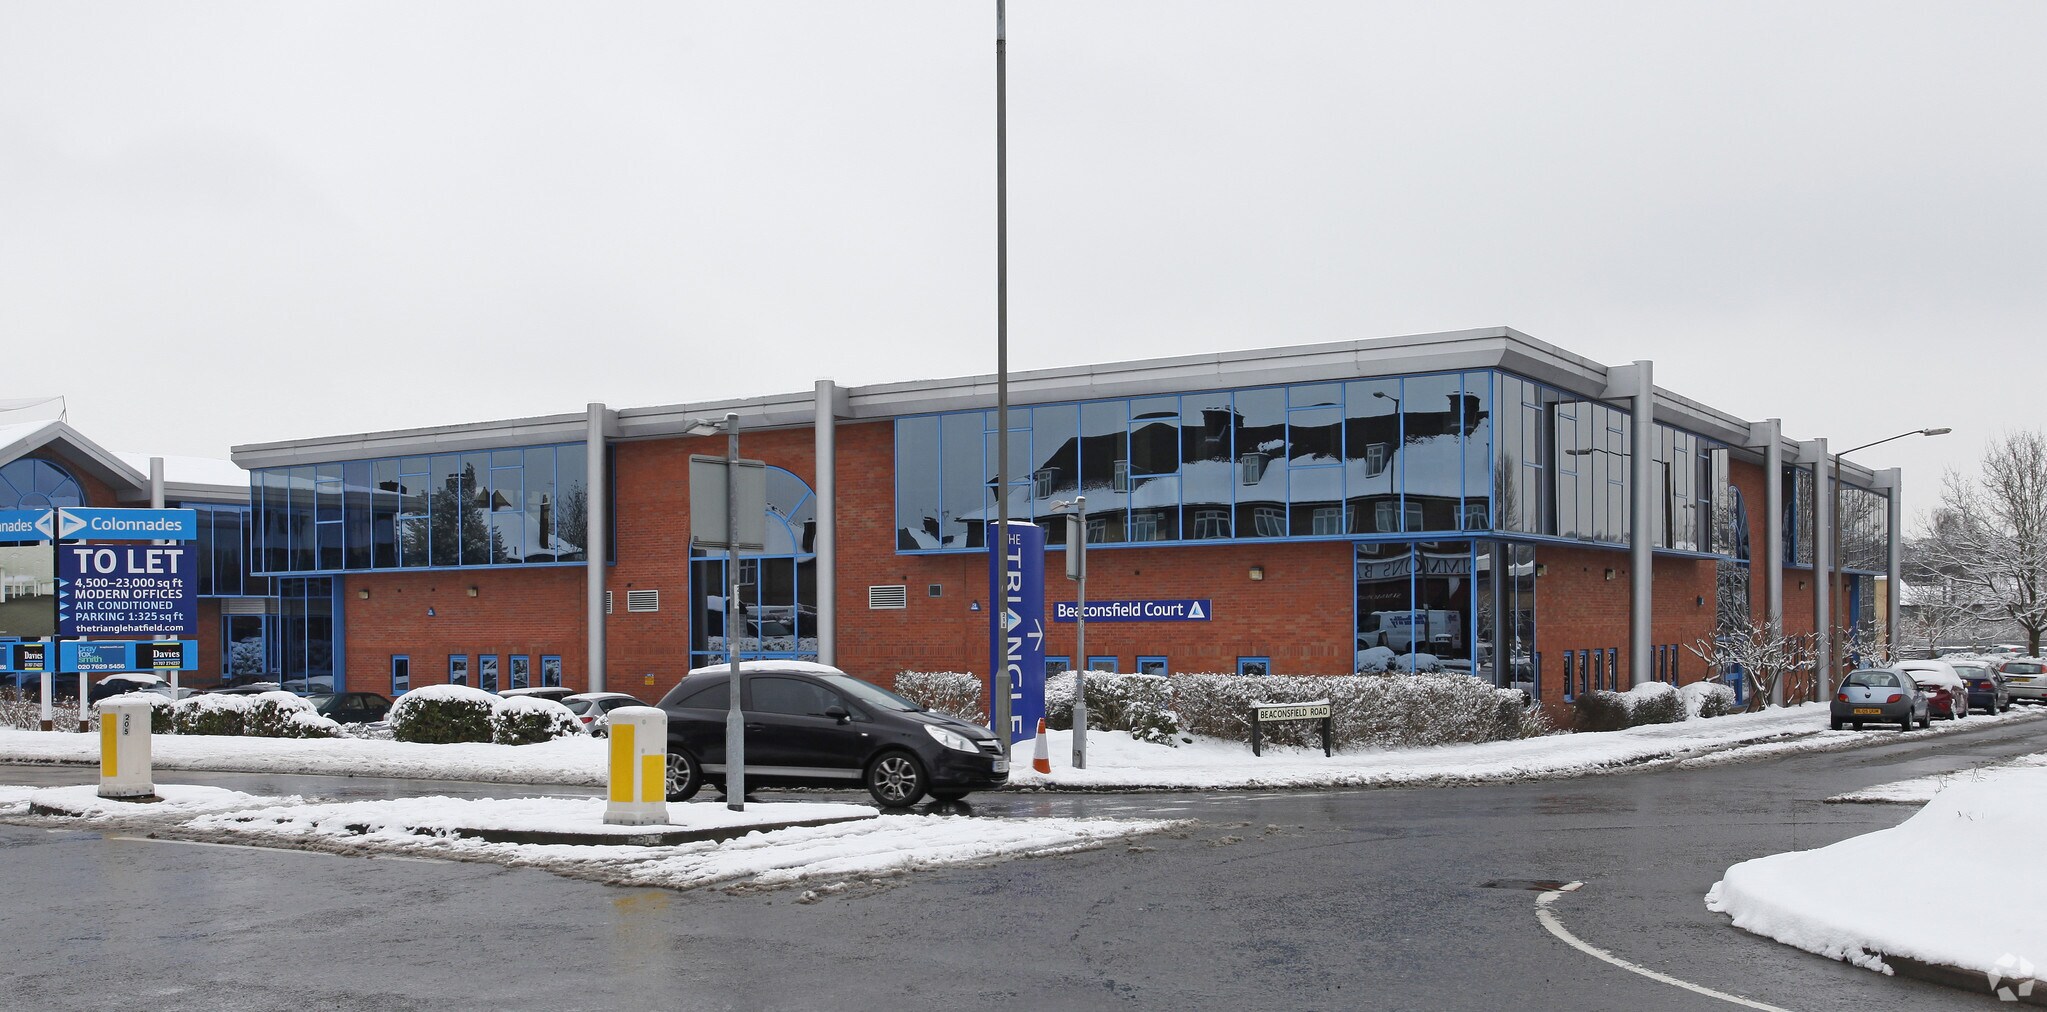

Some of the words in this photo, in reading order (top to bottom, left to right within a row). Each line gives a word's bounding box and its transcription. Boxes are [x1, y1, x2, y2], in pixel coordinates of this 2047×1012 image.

[0, 519, 32, 532] nades
[91, 517, 182, 531] Colonnades
[1007, 533, 1021, 545] HE
[73, 549, 117, 574] TO
[127, 549, 183, 574] LET
[157, 580, 170, 590] sq
[171, 578, 183, 588] ft
[75, 589, 129, 599] MODERN
[133, 589, 183, 599] OFFICES
[75, 601, 94, 610] AIR
[98, 601, 173, 610] CONDITIONED
[1057, 602, 1141, 618] Beaconsfield
[1144, 602, 1184, 617] Court
[75, 612, 125, 621] PARKING
[128, 612, 157, 621] 1:325
[160, 614, 172, 623] sq
[173, 612, 183, 621] ft
[76, 624, 184, 634] thetrianglehatfield.com
[78, 645, 97, 654] bray
[78, 650, 92, 658] fox
[153, 650, 180, 658] Davies
[24, 651, 43, 660] Davies
[78, 655, 103, 663] smith
[1260, 708, 1307, 719] BEACONSFIELD
[1310, 707, 1328, 716] ROAD
